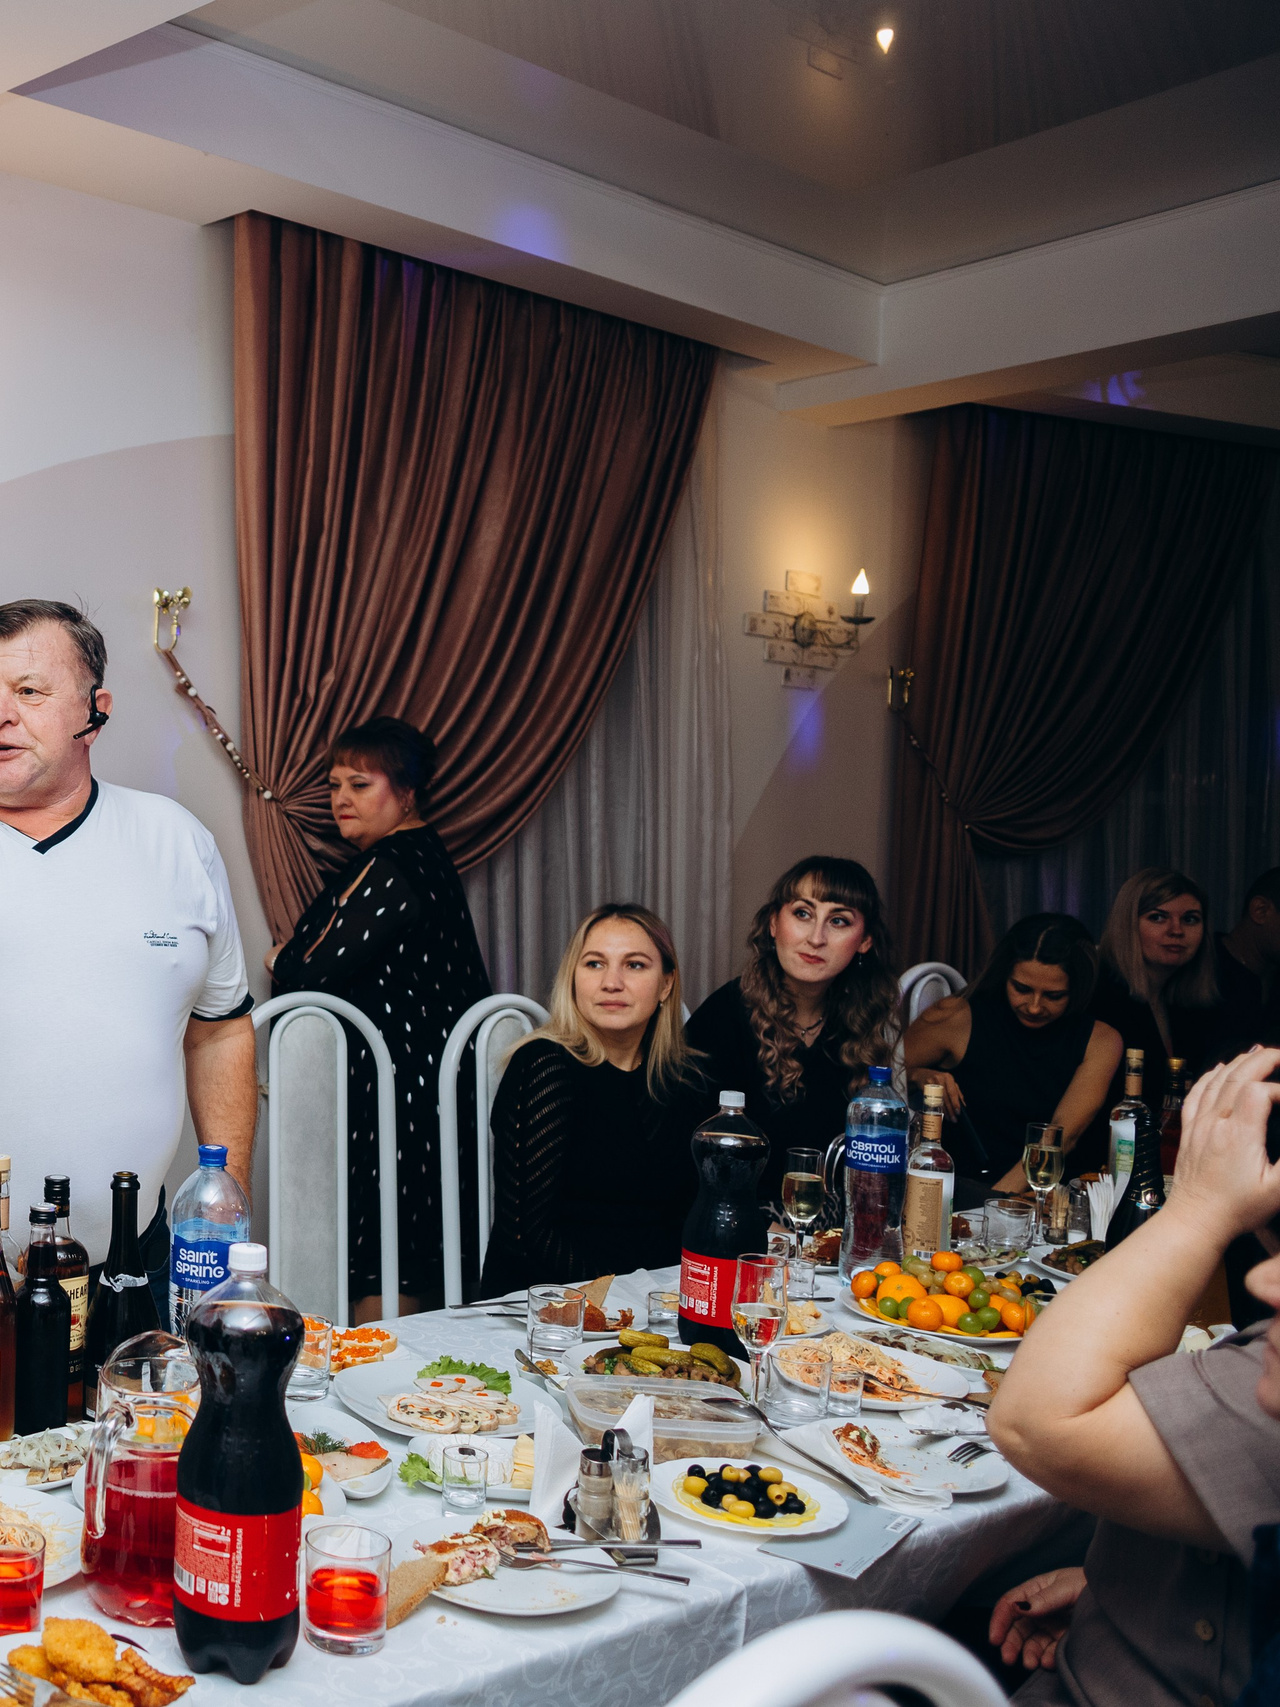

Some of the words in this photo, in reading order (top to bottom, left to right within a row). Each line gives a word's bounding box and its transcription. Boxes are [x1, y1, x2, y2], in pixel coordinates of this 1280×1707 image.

[851, 1140, 896, 1154] СВЯТОЙ
[846, 1148, 901, 1164] ИСТОЧНИК
[184, 1277, 210, 1285] SPARKLING
